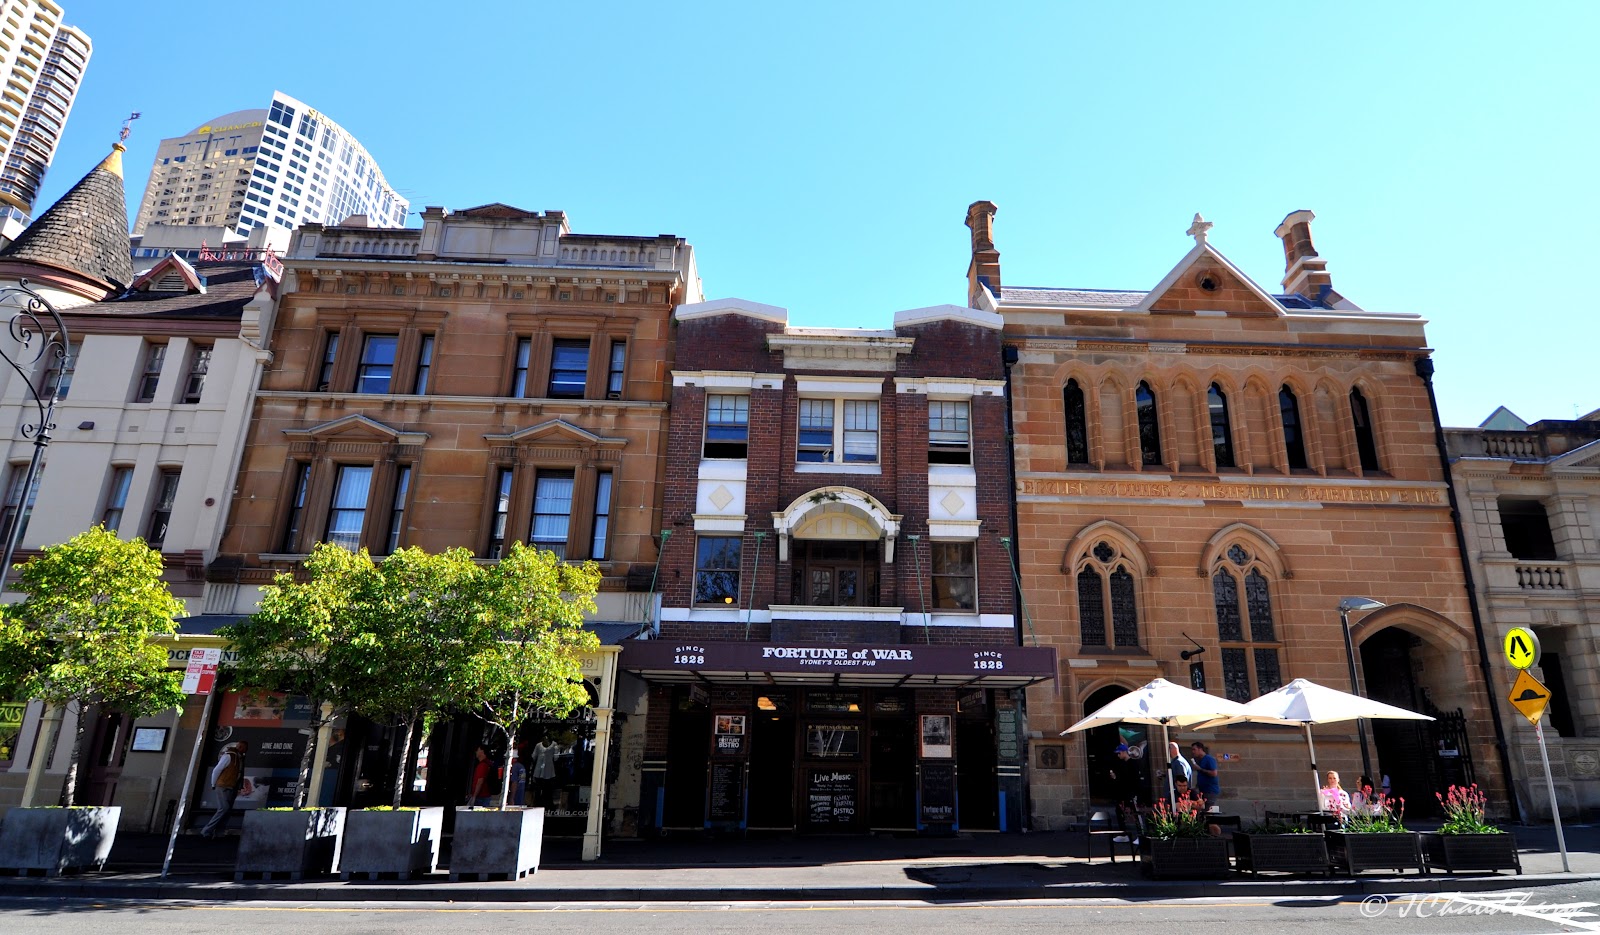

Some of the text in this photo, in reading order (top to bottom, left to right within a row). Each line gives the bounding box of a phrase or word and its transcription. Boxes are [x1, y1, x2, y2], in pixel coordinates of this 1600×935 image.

[675, 645, 705, 654] SINCE
[762, 647, 913, 660] FORTUNE of WAR
[674, 655, 705, 664] 1828
[973, 651, 1003, 659] SINCE
[973, 660, 1004, 669] 1828
